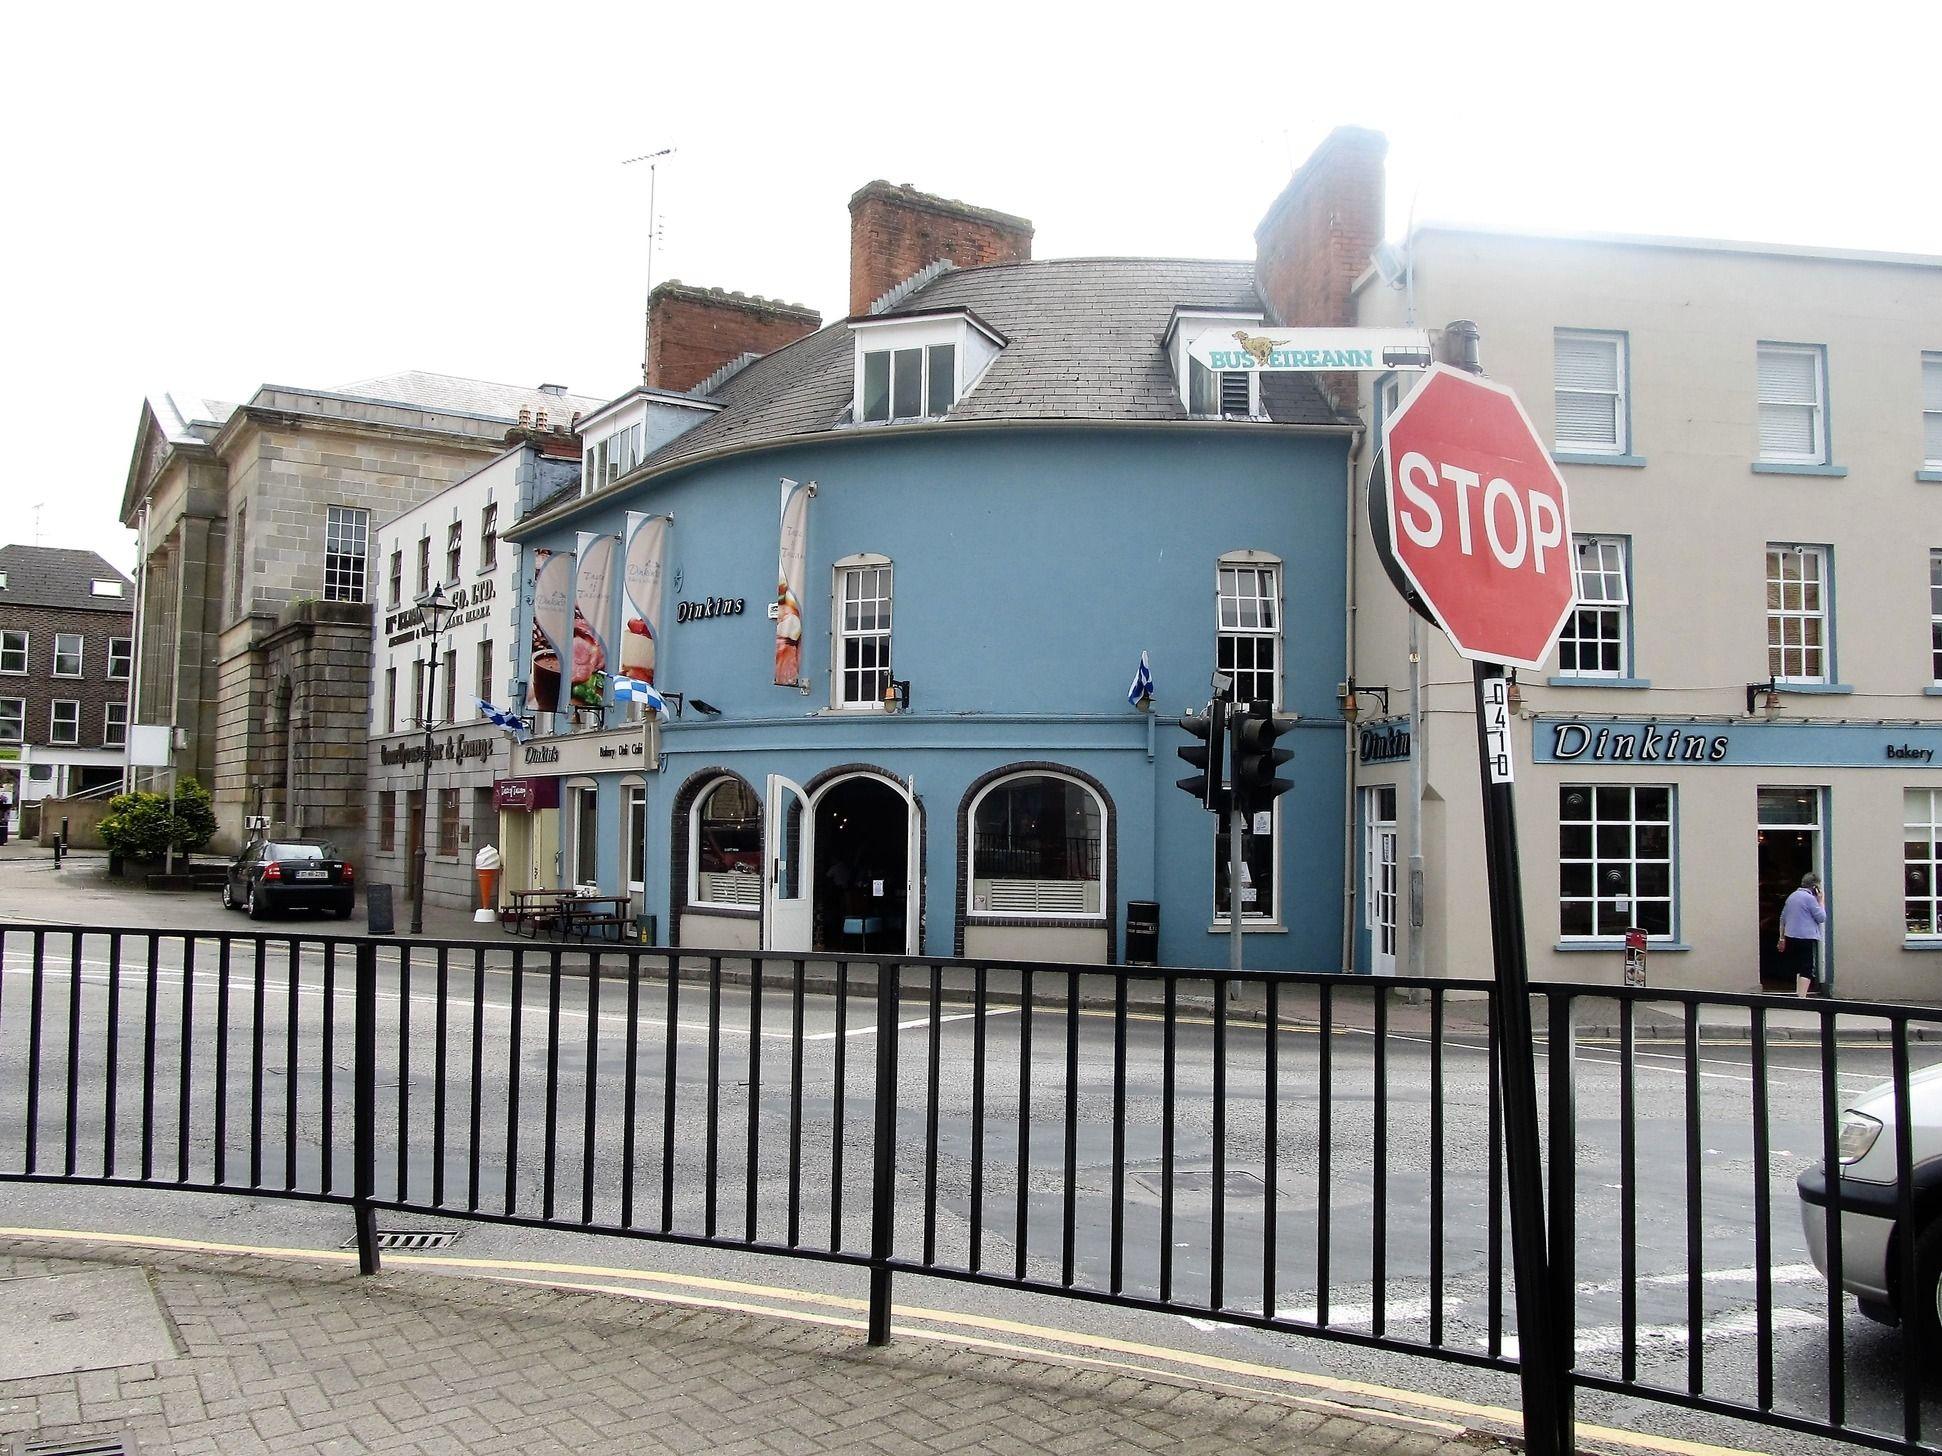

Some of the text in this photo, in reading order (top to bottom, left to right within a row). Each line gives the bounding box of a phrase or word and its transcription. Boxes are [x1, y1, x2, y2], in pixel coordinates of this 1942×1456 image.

[1209, 350, 1373, 369] BUS EIREANN
[1399, 452, 1562, 574] STOP
[676, 597, 745, 624] Dinkins
[1360, 726, 1411, 761] Dinkin
[1493, 683, 1508, 776] 0410
[1553, 723, 1730, 761] Dinkins
[1887, 743, 1935, 763] Bakery
